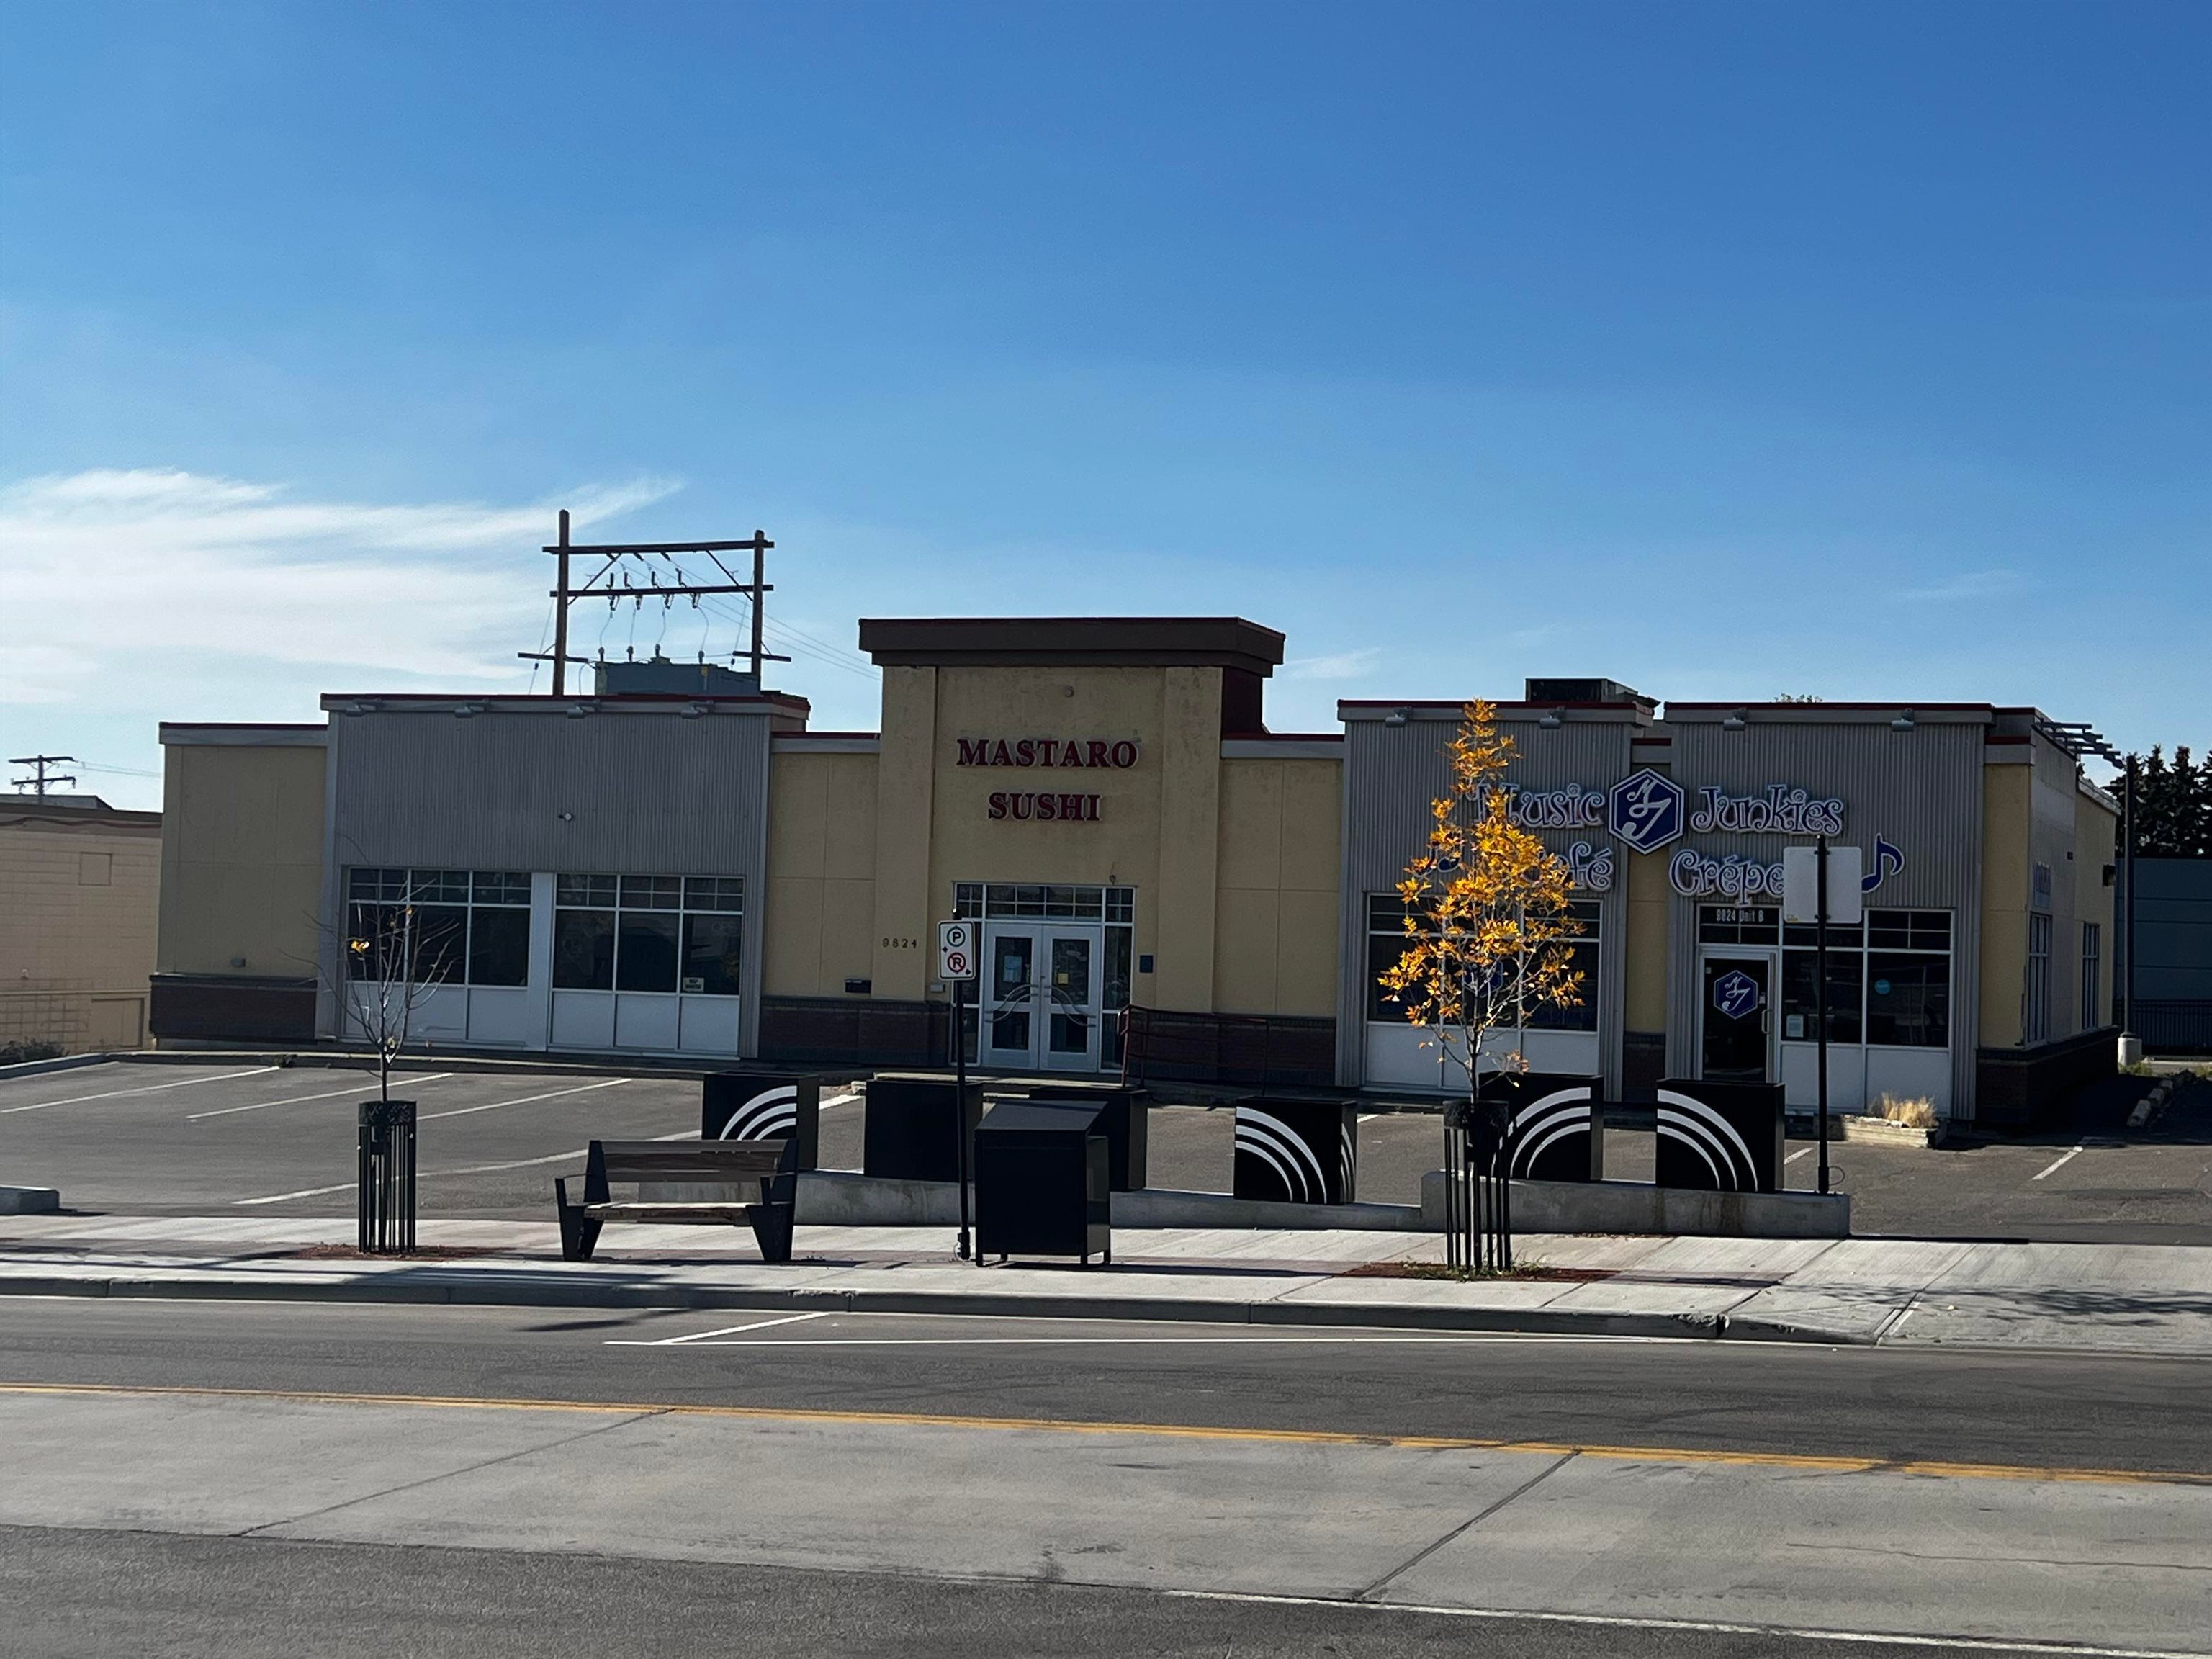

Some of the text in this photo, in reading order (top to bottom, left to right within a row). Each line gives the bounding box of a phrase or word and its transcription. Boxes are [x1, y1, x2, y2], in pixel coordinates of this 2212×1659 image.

[956, 739, 1138, 769] MASTARO
[988, 791, 1102, 822] SUSHI
[1691, 785, 1843, 836] Junkies
[1669, 849, 1784, 907] Crépe
